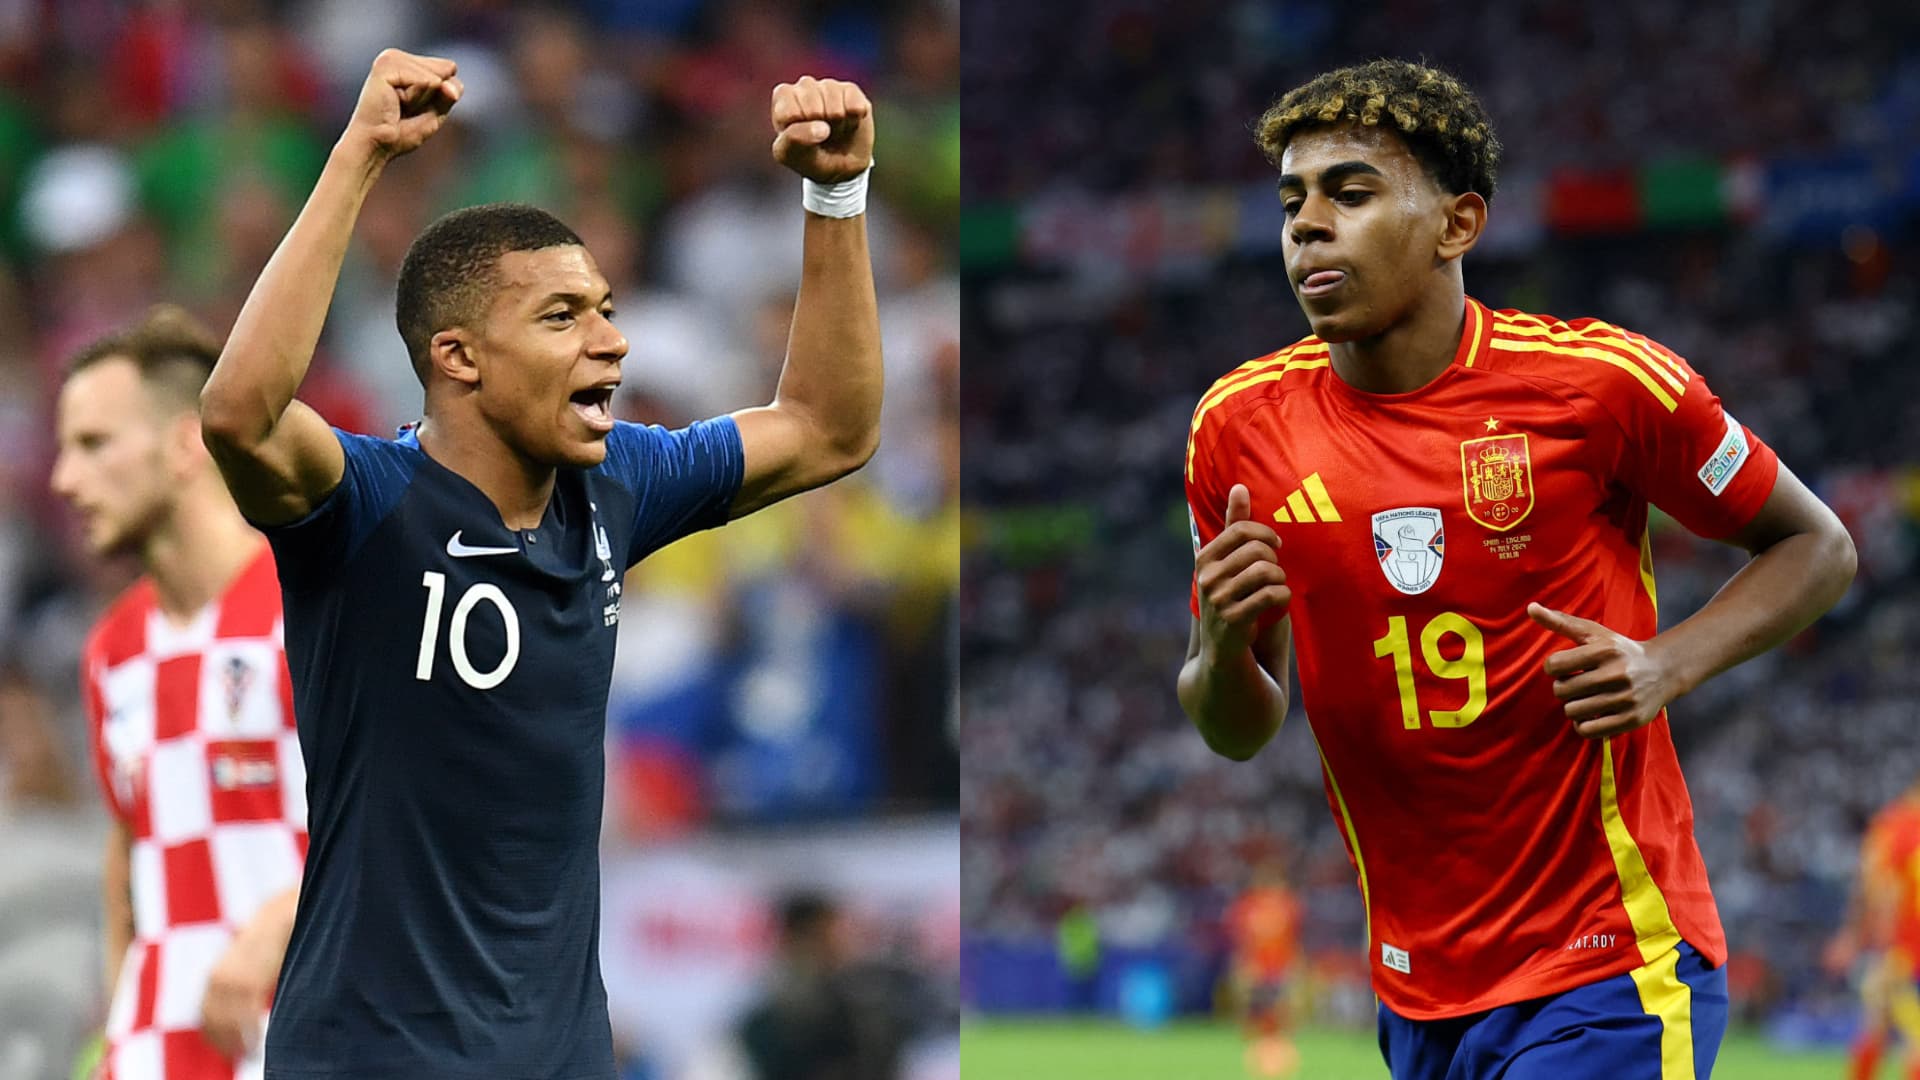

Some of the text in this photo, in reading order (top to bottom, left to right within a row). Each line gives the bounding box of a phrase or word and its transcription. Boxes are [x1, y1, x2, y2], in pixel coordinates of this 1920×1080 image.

[1506, 534, 1532, 544] ENGLAND
[1499, 551, 1520, 560] BERLIN
[1397, 583, 1419, 592] WINNER
[416, 570, 521, 690] 10
[1373, 611, 1488, 730] 19
